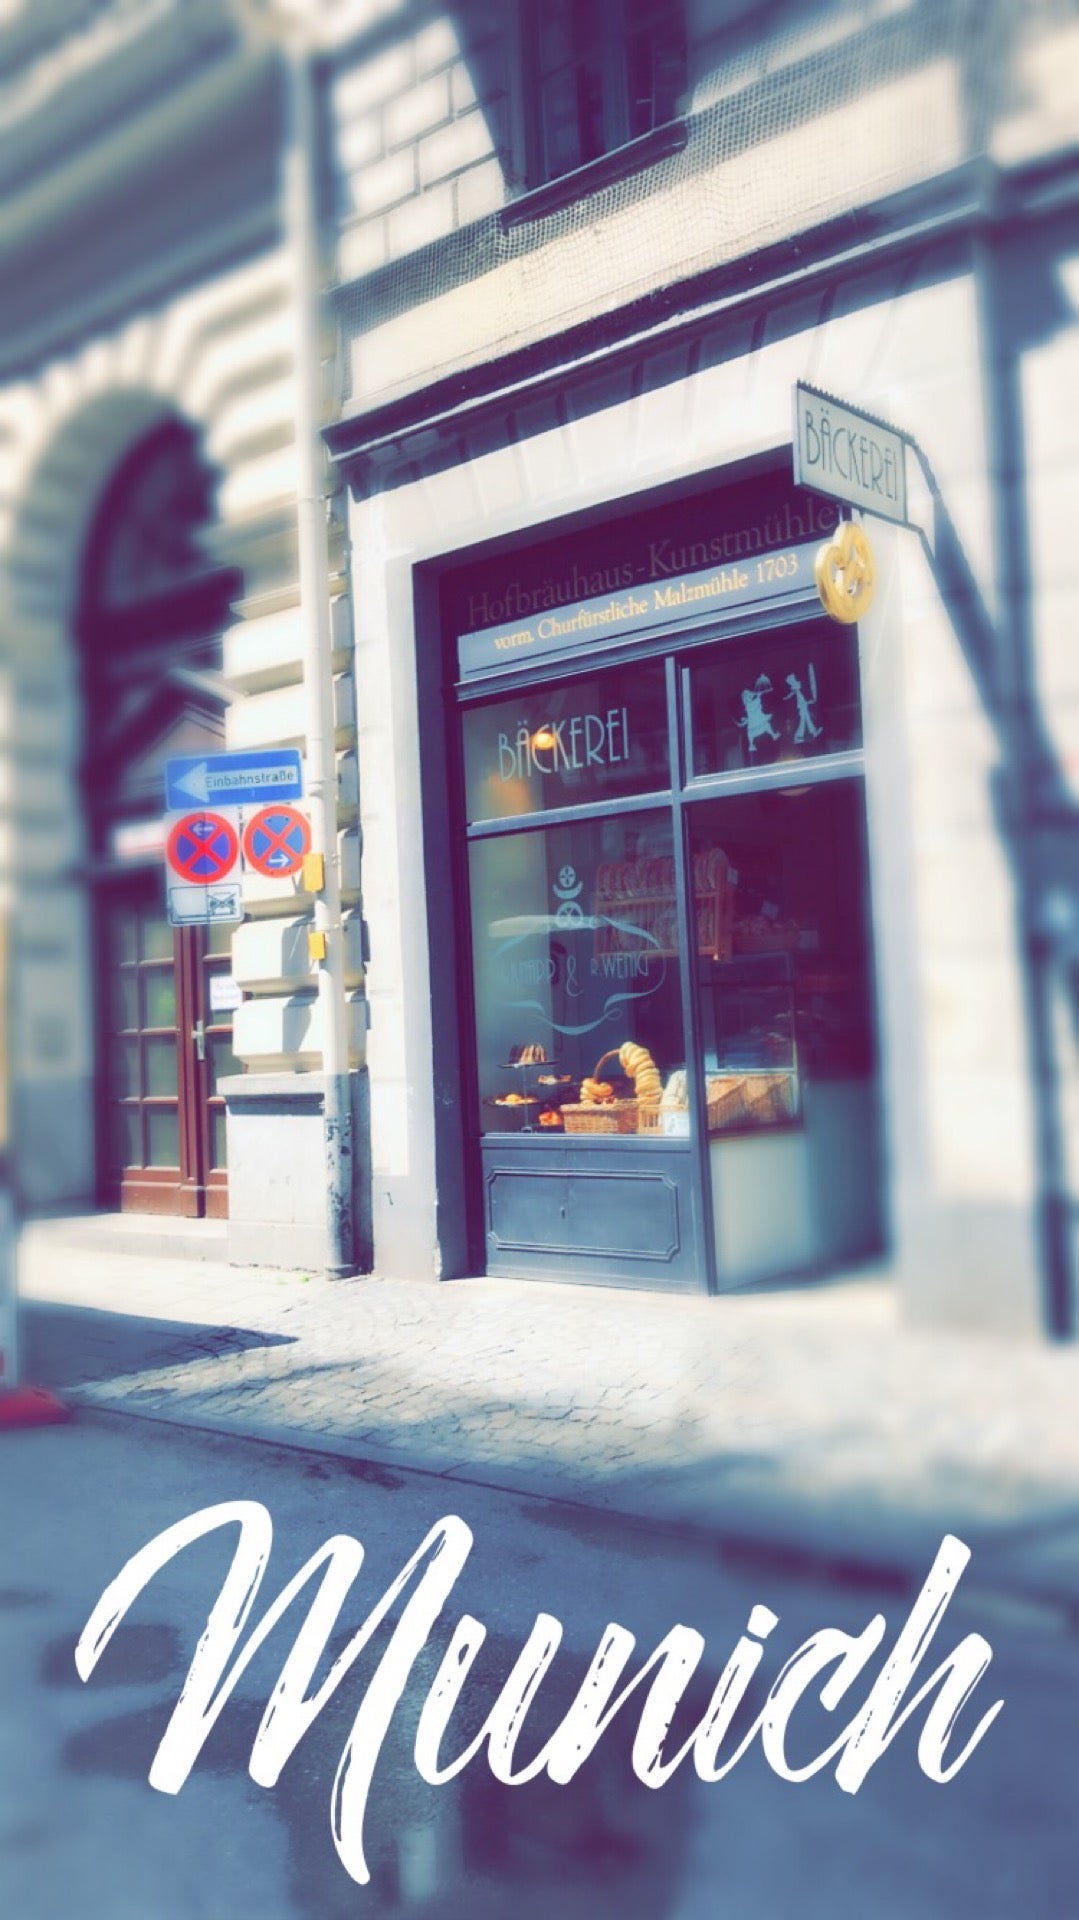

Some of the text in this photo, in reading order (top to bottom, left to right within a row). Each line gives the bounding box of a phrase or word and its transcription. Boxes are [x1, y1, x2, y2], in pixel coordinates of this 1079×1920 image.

[804, 407, 898, 501] BÄCKEREI
[467, 496, 837, 627] Hofbräuhaus-Kunstmühle
[494, 552, 799, 650] vorm. Churfürstliche Malzmühle 1703
[205, 770, 294, 788] Einbahnstraße
[498, 706, 630, 783] BÄCKEREI
